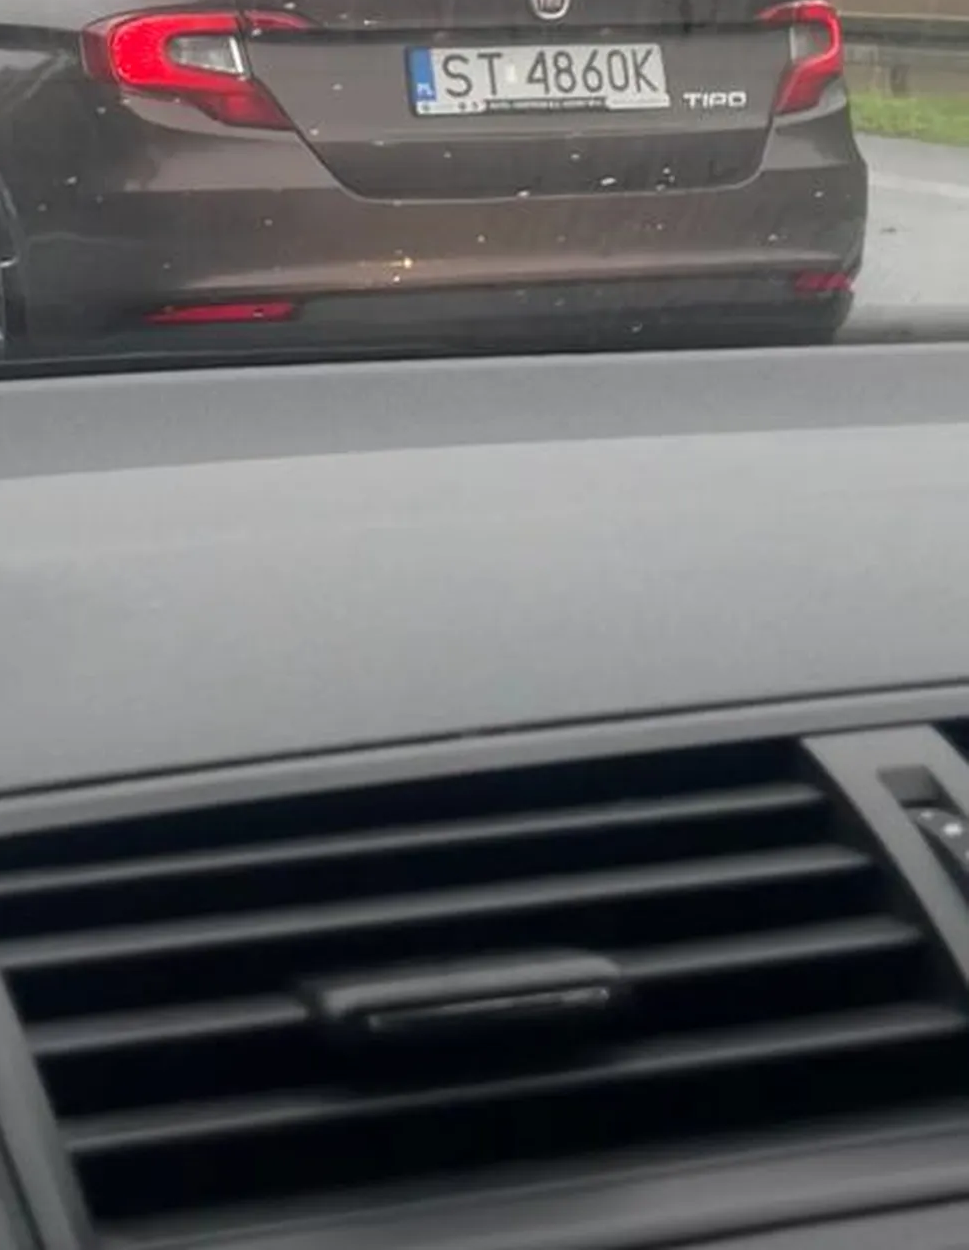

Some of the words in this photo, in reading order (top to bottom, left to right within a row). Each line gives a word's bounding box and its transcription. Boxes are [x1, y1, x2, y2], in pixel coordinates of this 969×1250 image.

[441, 52, 503, 98] ST
[526, 49, 658, 95] 4860K
[682, 91, 747, 109] TIPO
